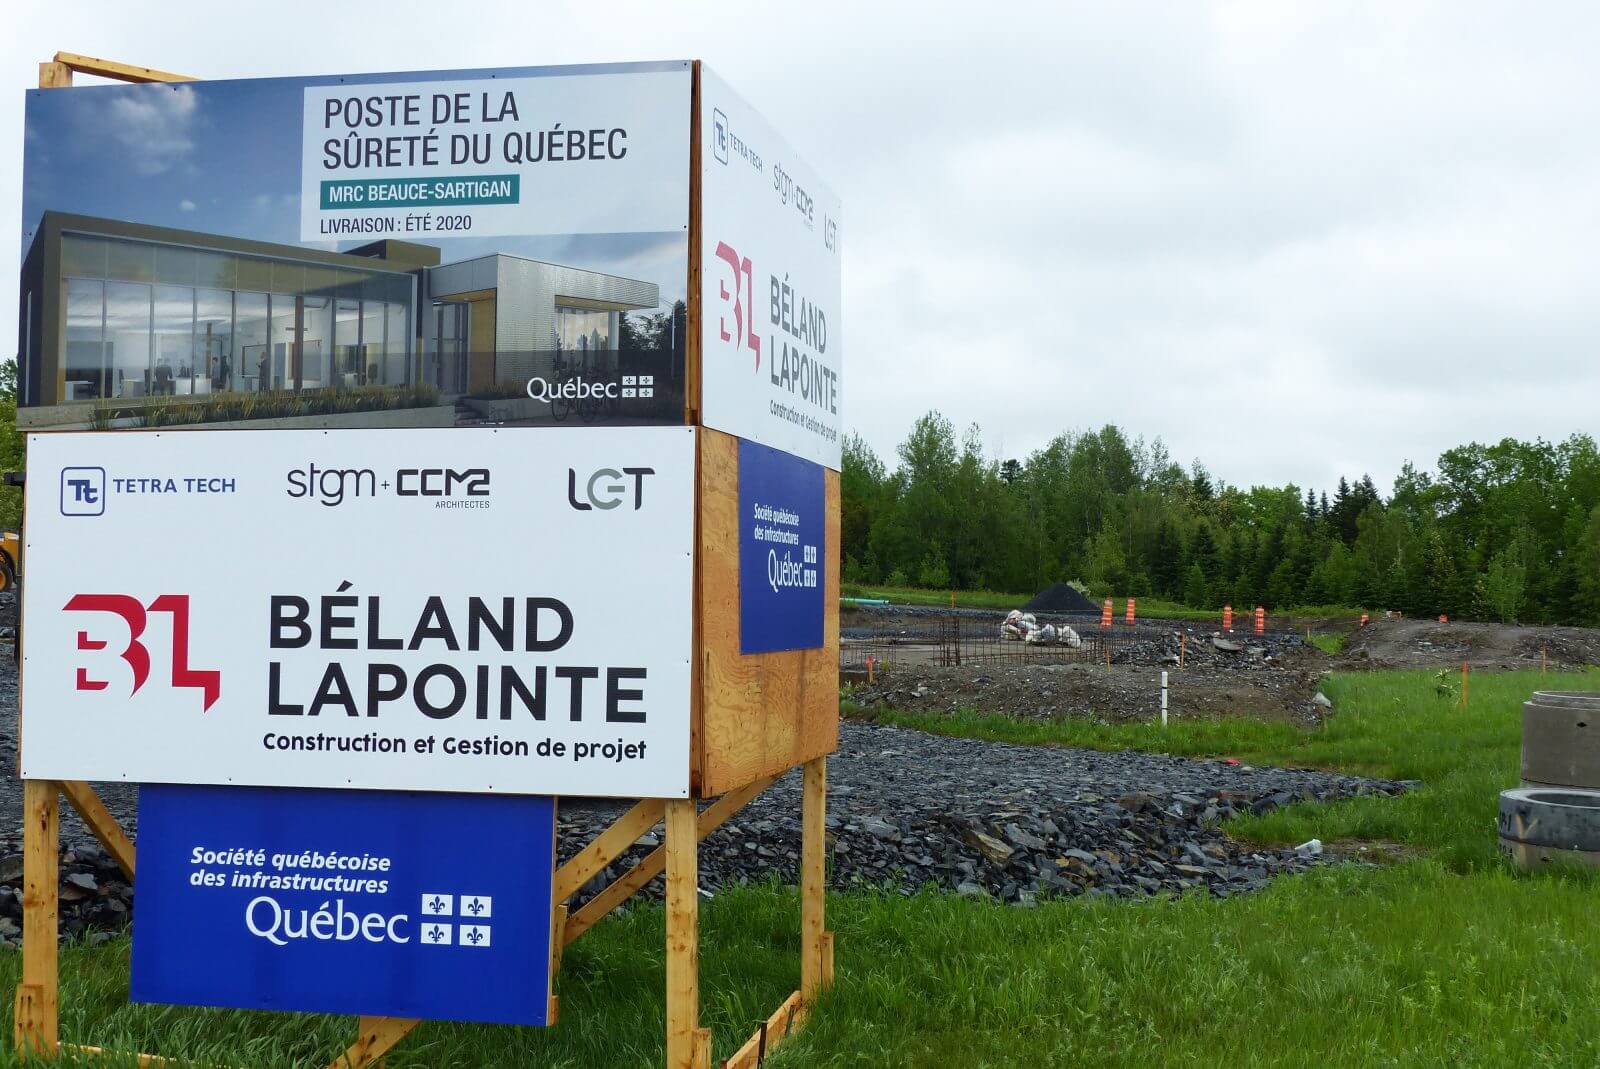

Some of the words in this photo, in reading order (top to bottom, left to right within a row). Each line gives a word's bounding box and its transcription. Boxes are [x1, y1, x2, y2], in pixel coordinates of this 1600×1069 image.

[324, 94, 421, 129] POSTE
[431, 92, 471, 125] DE
[481, 91, 520, 123] LA
[322, 127, 439, 170] SÛRETÉ
[450, 133, 492, 165] DU
[503, 123, 627, 165] QUÉBEC
[729, 133, 748, 160] TETRA
[749, 150, 763, 173] TECH
[329, 185, 364, 203] MRC
[368, 180, 511, 202] BEAUCE-SARTIGAN
[405, 213, 432, 232] ÉTÉ
[436, 215, 472, 231] 2020
[770, 272, 827, 354] BÉLAND
[526, 376, 618, 402] Québec
[771, 335, 837, 415] LAPOINTE
[112, 478, 178, 494] TETRA
[183, 478, 236, 493] TECH
[286, 462, 376, 507] stgm
[396, 468, 490, 497] CCM2
[568, 467, 656, 511] LGT
[435, 500, 490, 509] ARCHITECTES
[754, 503, 773, 523] Société
[772, 508, 799, 527] québécoise
[754, 524, 764, 541] des
[764, 526, 799, 545] infrastructures
[768, 548, 804, 593] Québec
[269, 579, 574, 653] BÉLAND
[61, 593, 221, 714] BL
[267, 661, 648, 724] LAPOINTE
[263, 732, 406, 754] Construction
[413, 734, 436, 755] et
[442, 735, 529, 758] Gestion
[536, 736, 567, 759] de
[573, 737, 647, 763] projet
[190, 846, 266, 868] Société
[271, 849, 391, 872] québécoise
[189, 868, 227, 888] des
[231, 870, 389, 894] infrastructures
[245, 896, 410, 946] Québec
